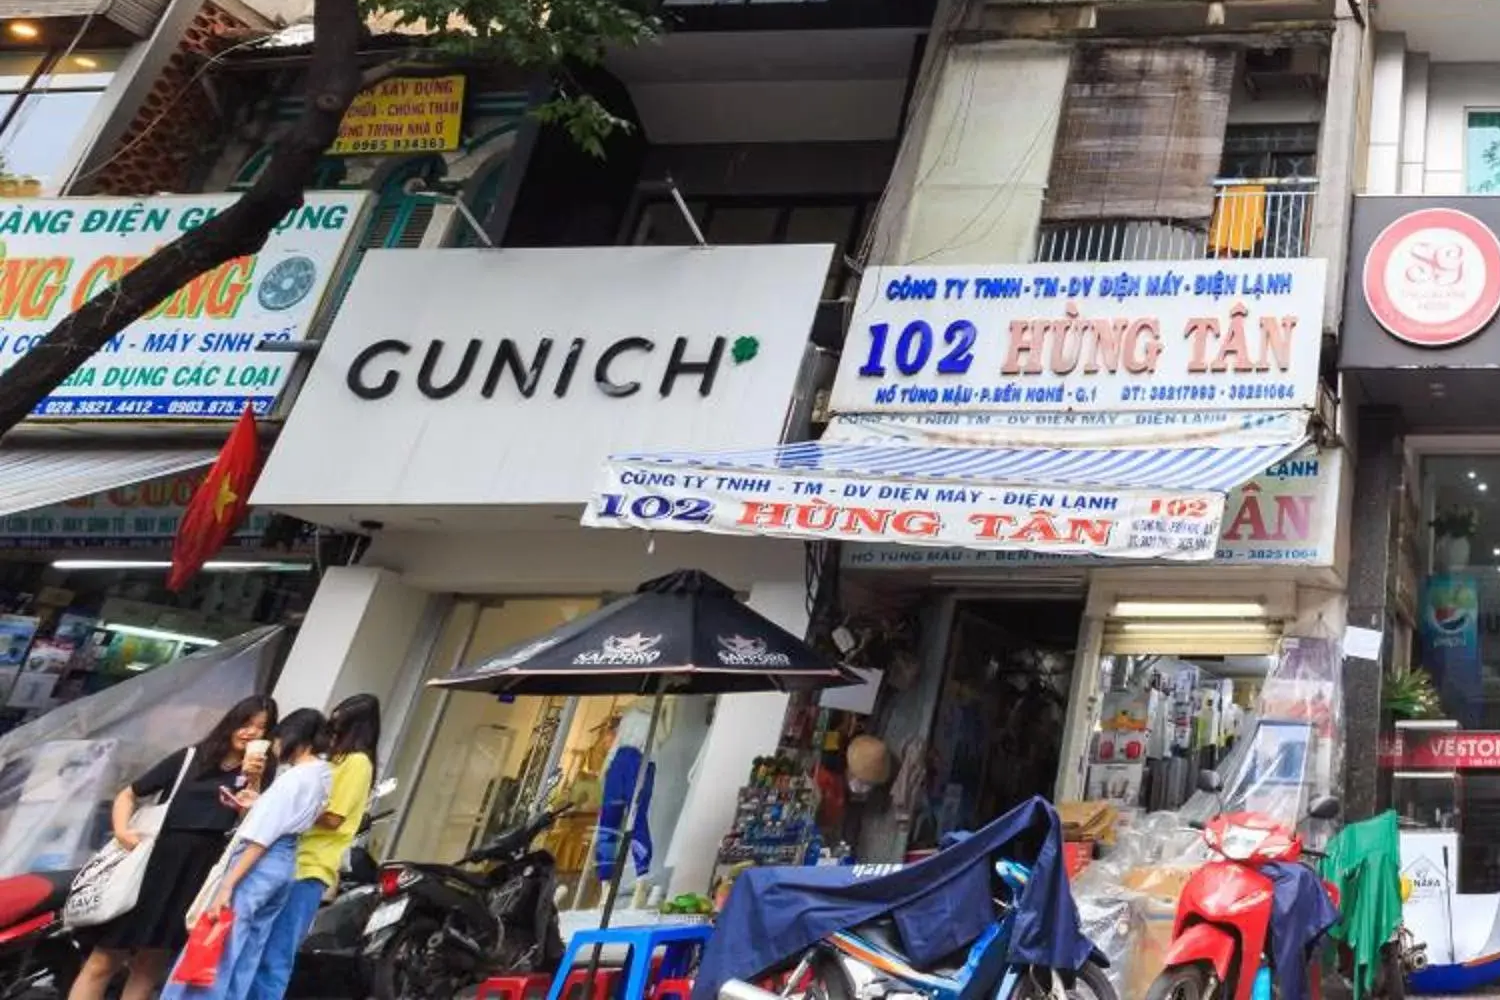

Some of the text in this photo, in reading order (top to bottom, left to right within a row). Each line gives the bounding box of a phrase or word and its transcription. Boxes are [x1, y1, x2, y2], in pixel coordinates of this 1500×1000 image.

[0, 204, 74, 233] ÀNG
[80, 202, 171, 237] ĐIỆN
[944, 278, 970, 299] TY
[1241, 271, 1294, 301] LẠNH
[199, 333, 254, 353] SINH
[859, 301, 1299, 377] 102 HÙNG TÂN
[101, 366, 169, 390] DỤNG
[172, 360, 220, 387] CÁC
[224, 366, 281, 391] LOẠI
[346, 335, 727, 400] GUNICH
[683, 475, 708, 488] TY
[716, 477, 772, 493] TNHH
[792, 481, 824, 495] TM
[843, 483, 872, 498] DV
[1265, 461, 1319, 480] LẠNH
[598, 493, 715, 524] 102
[736, 497, 945, 537] HÙNG
[967, 509, 1114, 546] TÂN
[1222, 482, 1316, 541] ÂN
